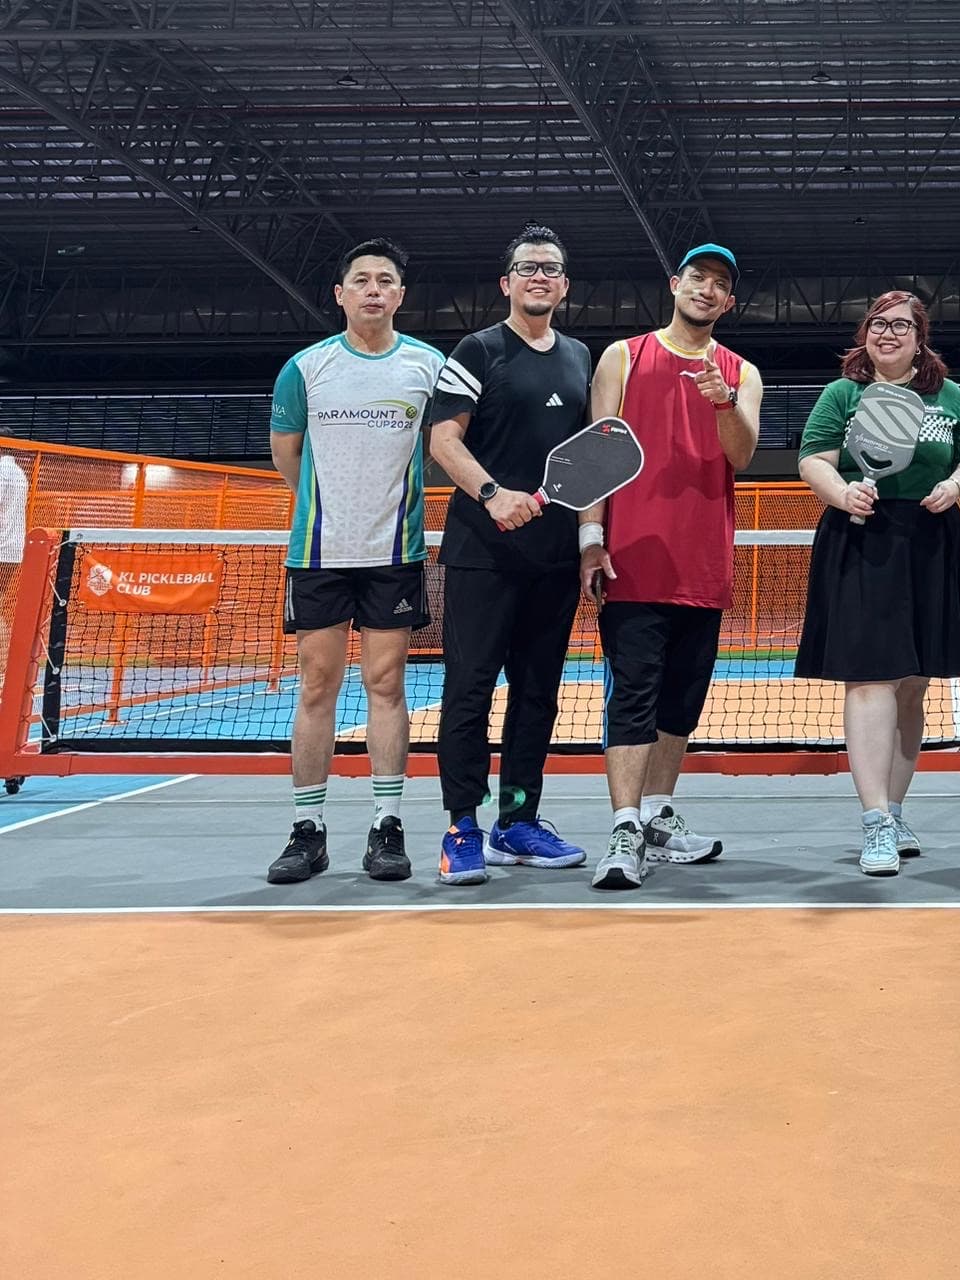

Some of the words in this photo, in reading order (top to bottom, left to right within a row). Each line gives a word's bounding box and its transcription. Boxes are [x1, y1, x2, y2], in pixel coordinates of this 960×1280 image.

[318, 409, 398, 420] PARAMOUNT
[119, 571, 136, 582] KL
[138, 572, 215, 584] PICKLEBALL
[116, 583, 152, 596] CLUB
